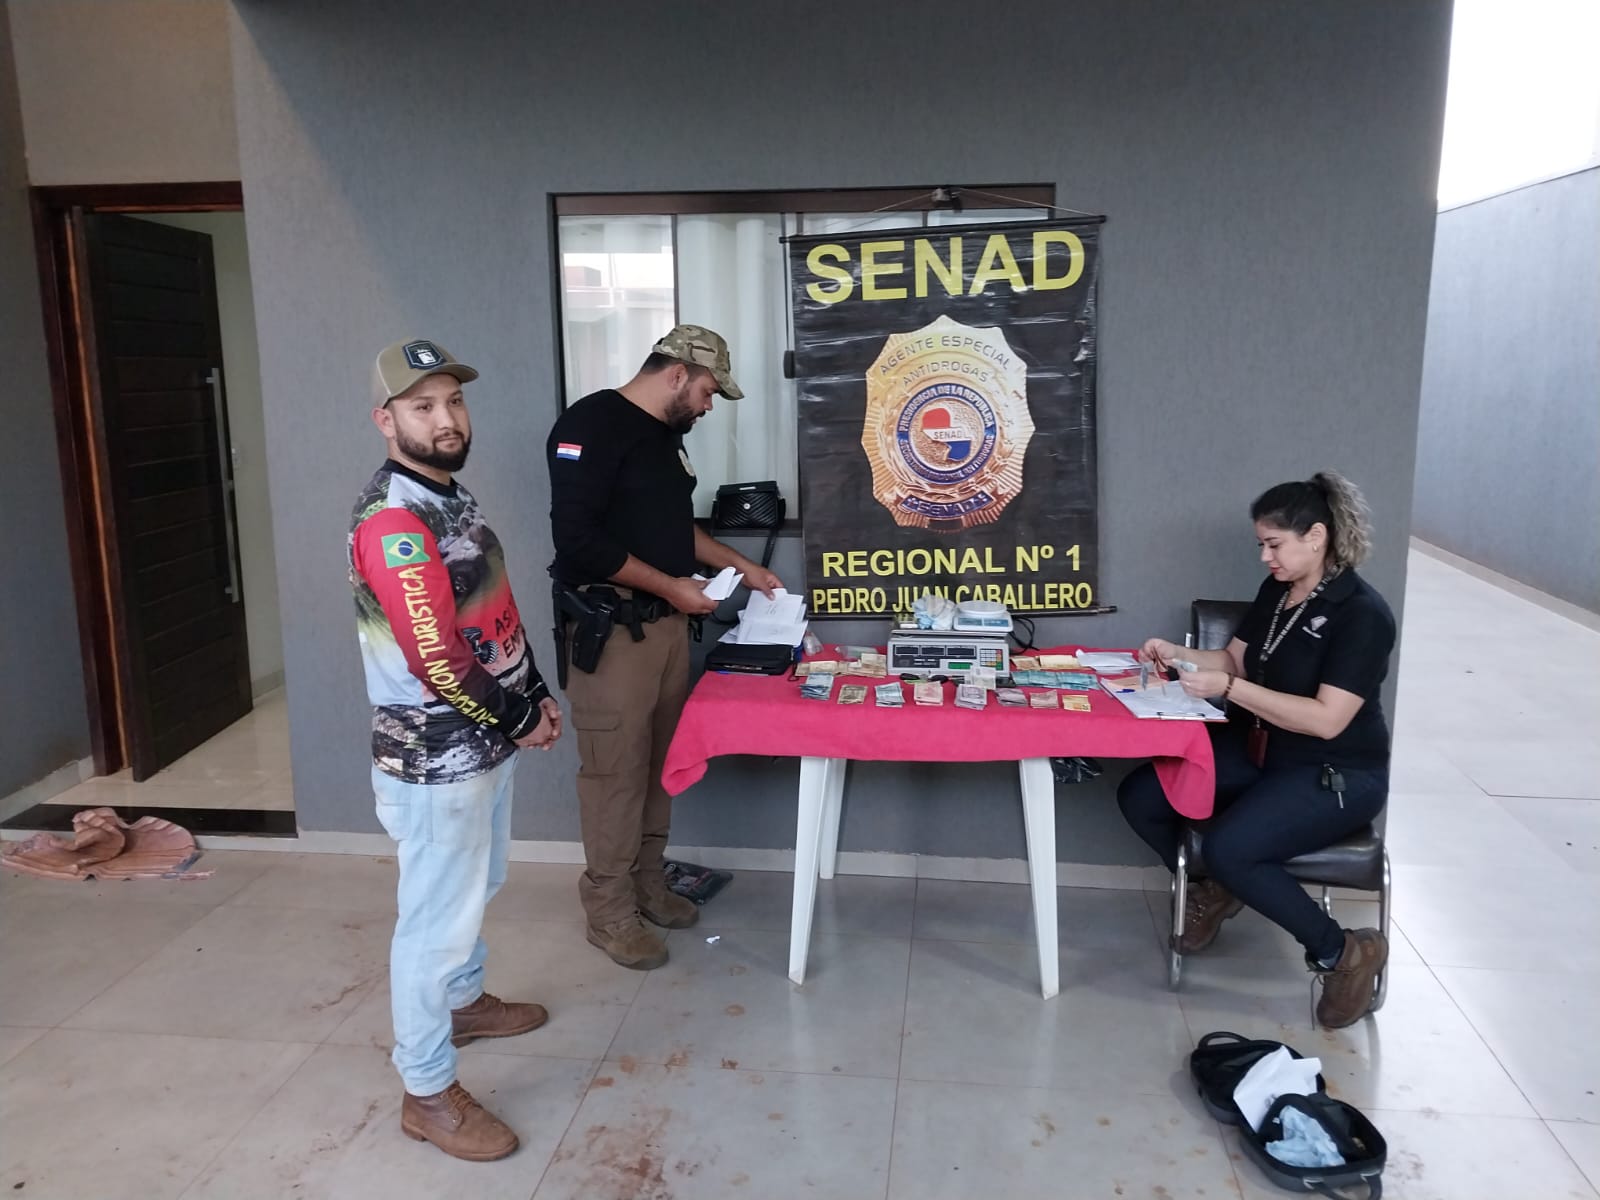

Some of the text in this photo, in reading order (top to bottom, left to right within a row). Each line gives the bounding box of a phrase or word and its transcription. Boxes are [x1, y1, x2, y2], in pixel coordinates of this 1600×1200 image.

[805, 230, 1085, 304] SENAD
[880, 335, 1010, 375] AGENTE ESPECIAL
[903, 361, 989, 386] ANTIDROGAS
[822, 544, 1081, 577] REGIONAL Nº 1
[398, 565, 447, 660] TURISTICA
[812, 587, 887, 614] PEDRO
[955, 582, 1093, 609] CABALLERO
